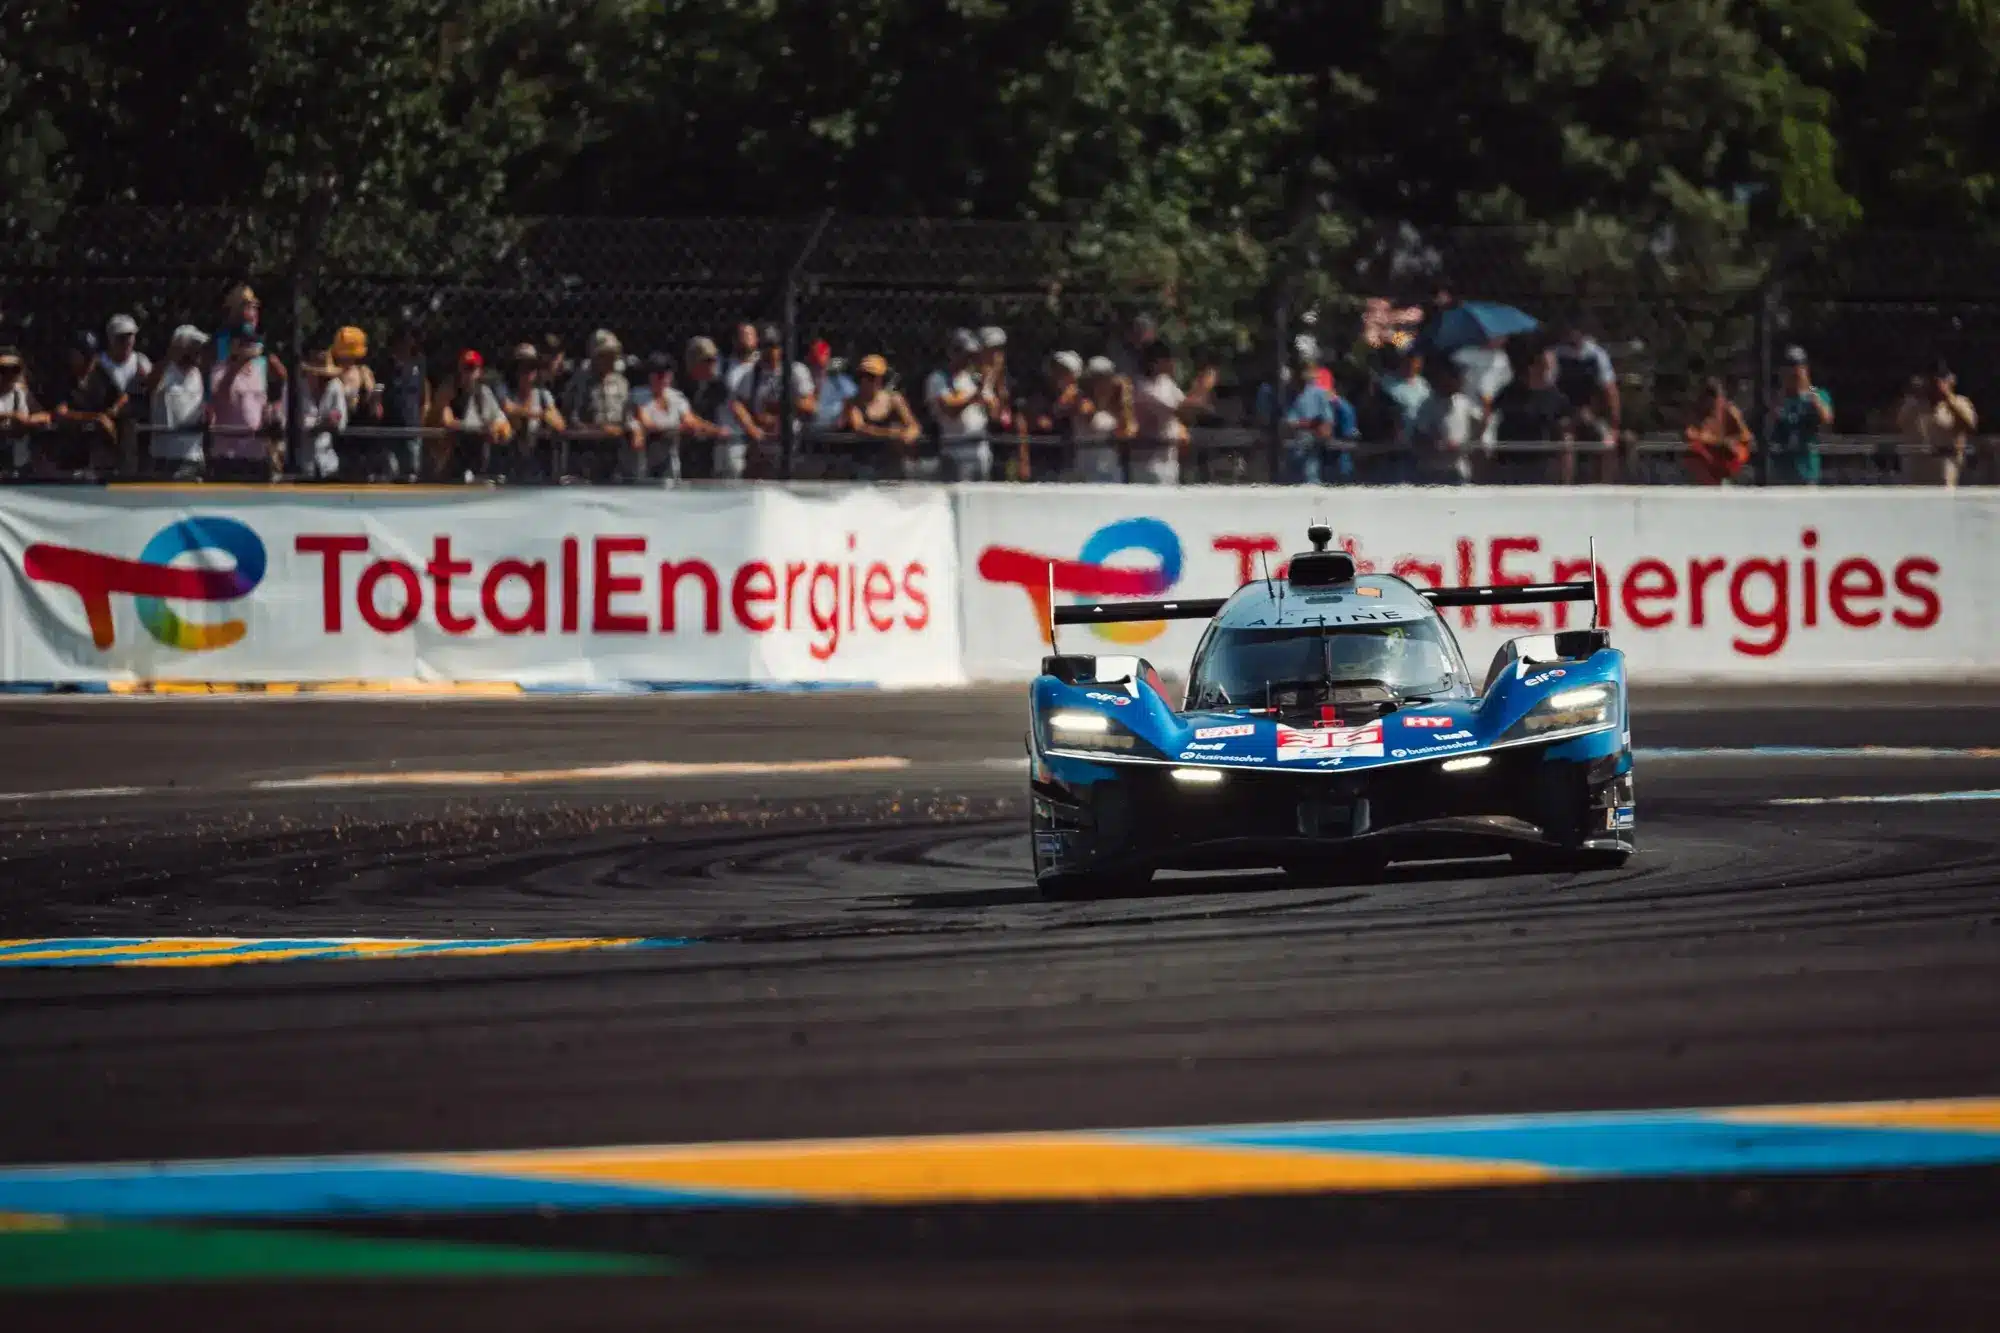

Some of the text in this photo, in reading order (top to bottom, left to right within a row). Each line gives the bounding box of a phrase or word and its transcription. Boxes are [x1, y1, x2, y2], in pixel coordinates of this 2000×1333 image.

[295, 534, 930, 661] TotalEnergies
[1211, 529, 1942, 657] TlEnergies
[1246, 610, 1403, 628] ALPINE
[1405, 716, 1450, 728] HY
[1406, 740, 1478, 756] businessolver
[1194, 752, 1267, 763] businessolver
